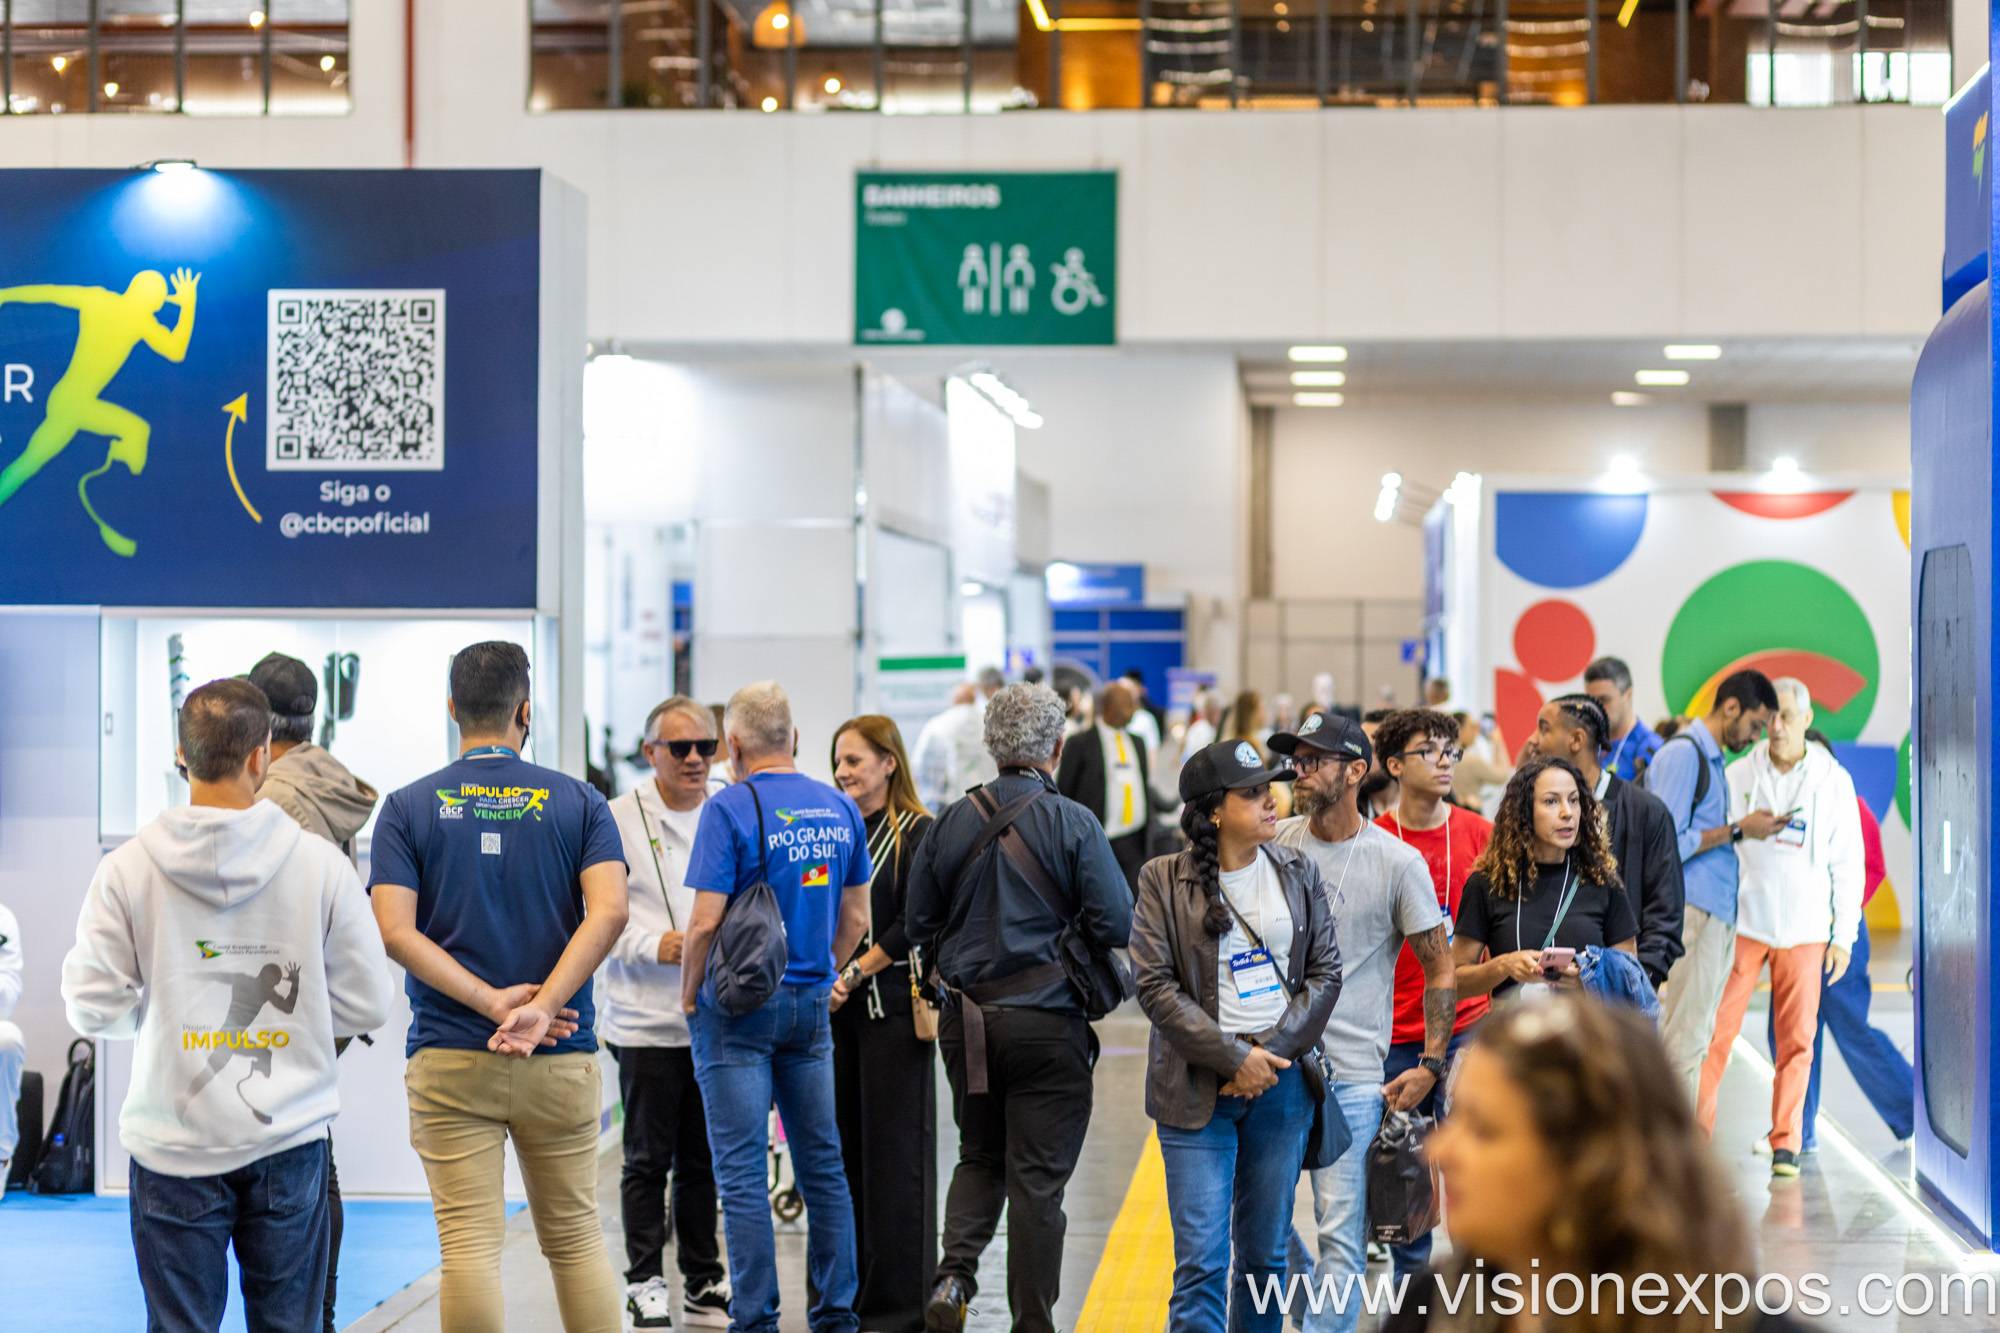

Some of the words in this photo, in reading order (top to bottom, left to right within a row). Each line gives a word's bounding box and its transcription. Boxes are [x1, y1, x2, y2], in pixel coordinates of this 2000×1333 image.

[863, 183, 1001, 208] BANHEIROS
[320, 480, 370, 507] Siga
[374, 484, 391, 502] o
[279, 511, 430, 538] @cbcpoficial
[460, 786, 522, 798] IMPULSO
[479, 796, 498, 804] PARA
[498, 796, 529, 804] CRESCER
[440, 806, 463, 815] CBCP
[473, 807, 523, 821] VENCER
[768, 830, 795, 850] RIO
[797, 826, 850, 844] GRANDE
[788, 845, 810, 862] DO
[813, 842, 838, 859] SUL
[182, 1029, 290, 1051] IMPULSO
